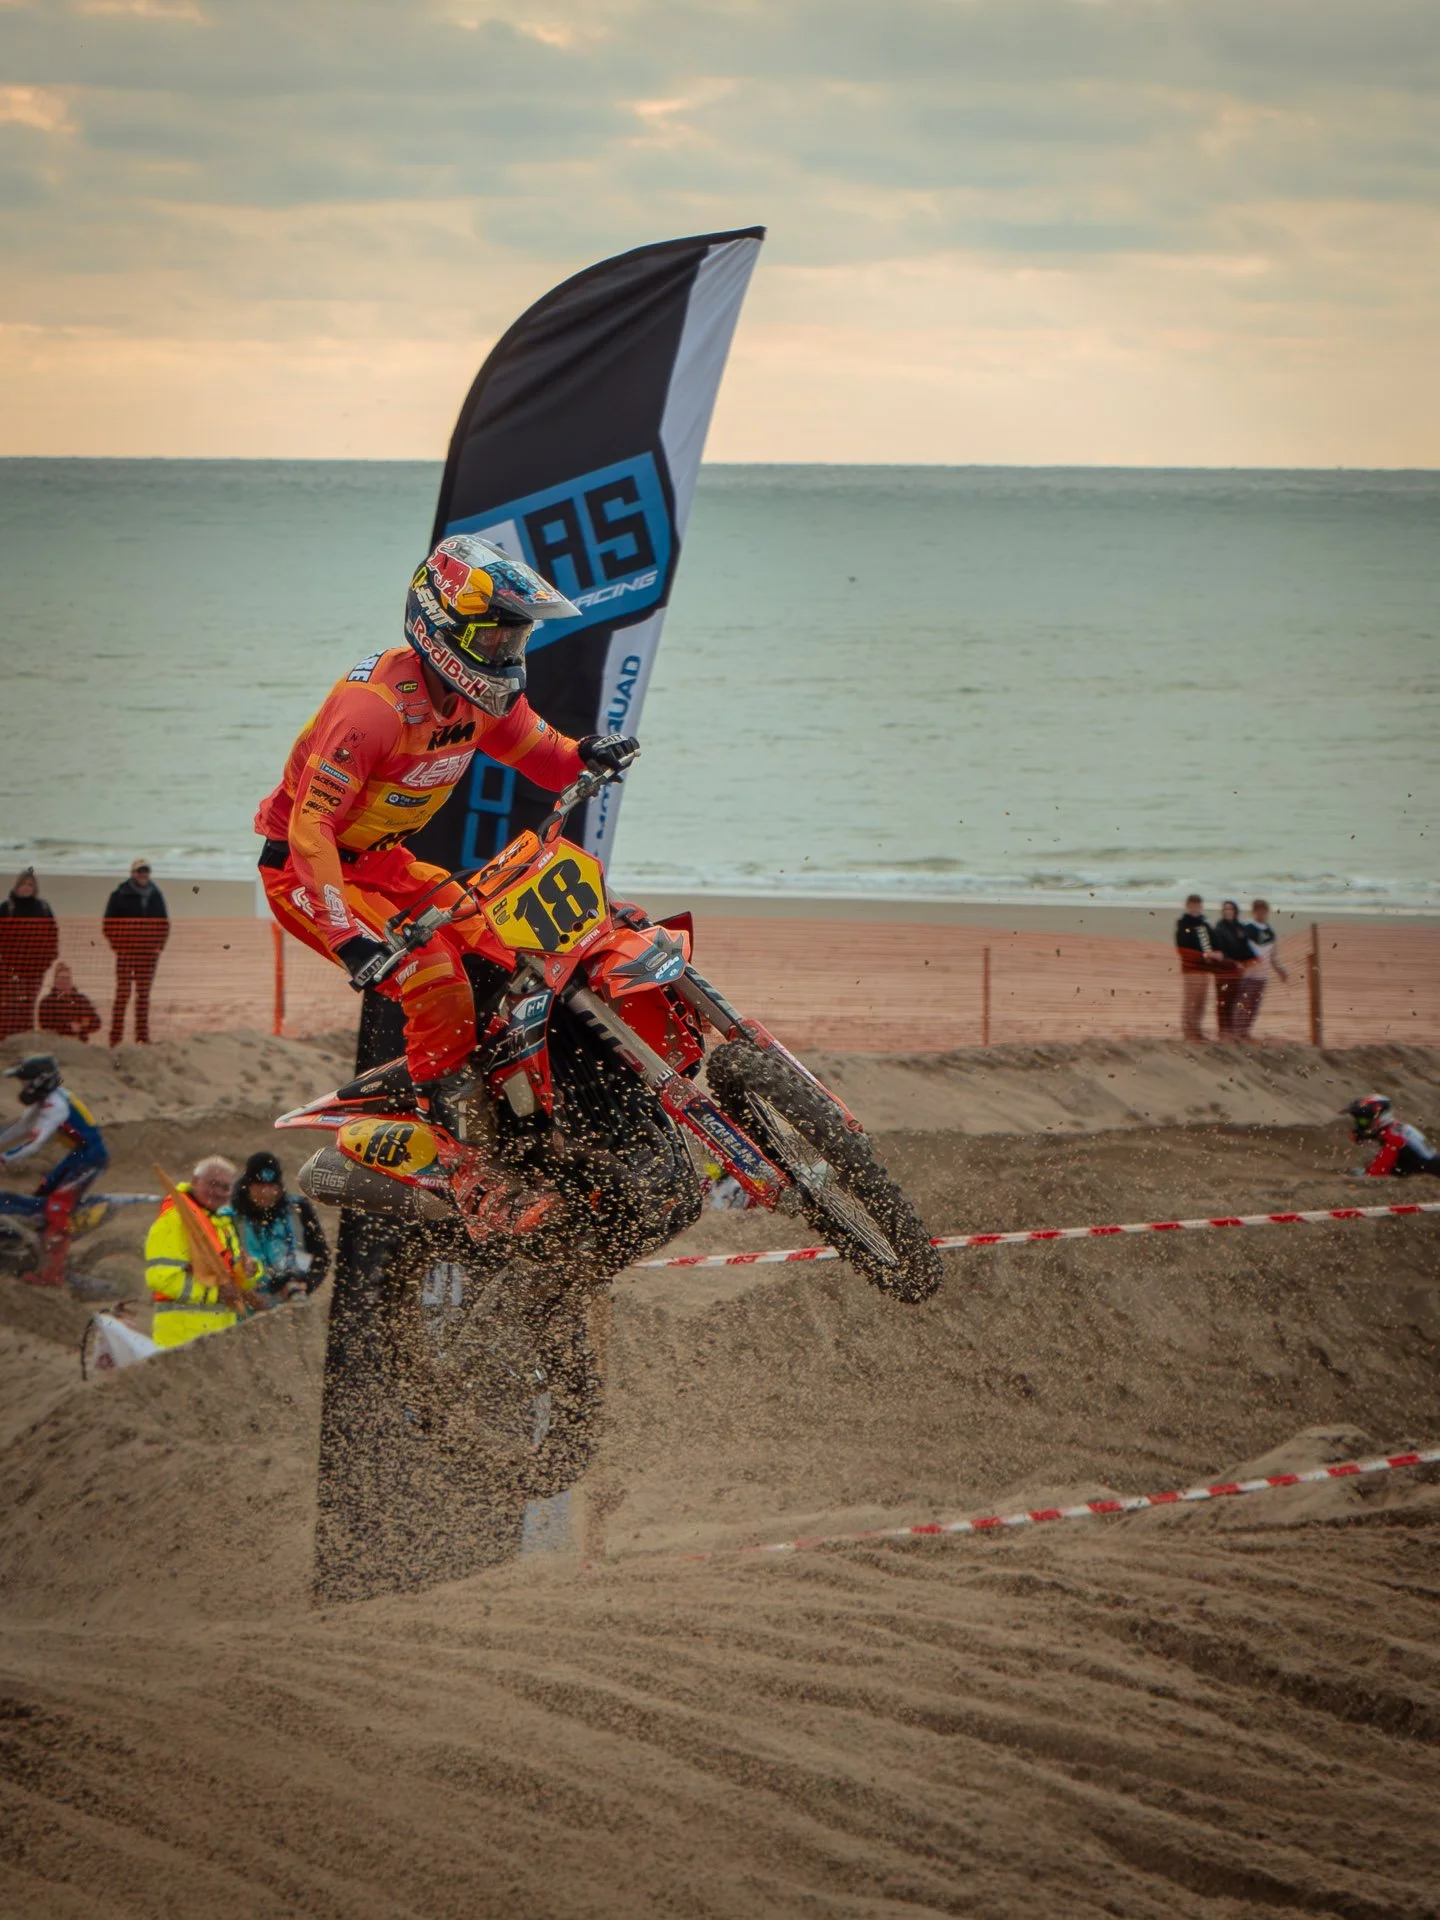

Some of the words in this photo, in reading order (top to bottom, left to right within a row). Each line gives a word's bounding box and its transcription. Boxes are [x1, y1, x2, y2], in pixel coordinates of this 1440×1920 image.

[412, 615, 449, 668] Red
[441, 656, 491, 701] Bull
[427, 718, 476, 751] KTM
[513, 858, 599, 951] 18
[363, 1121, 415, 1168] 18
